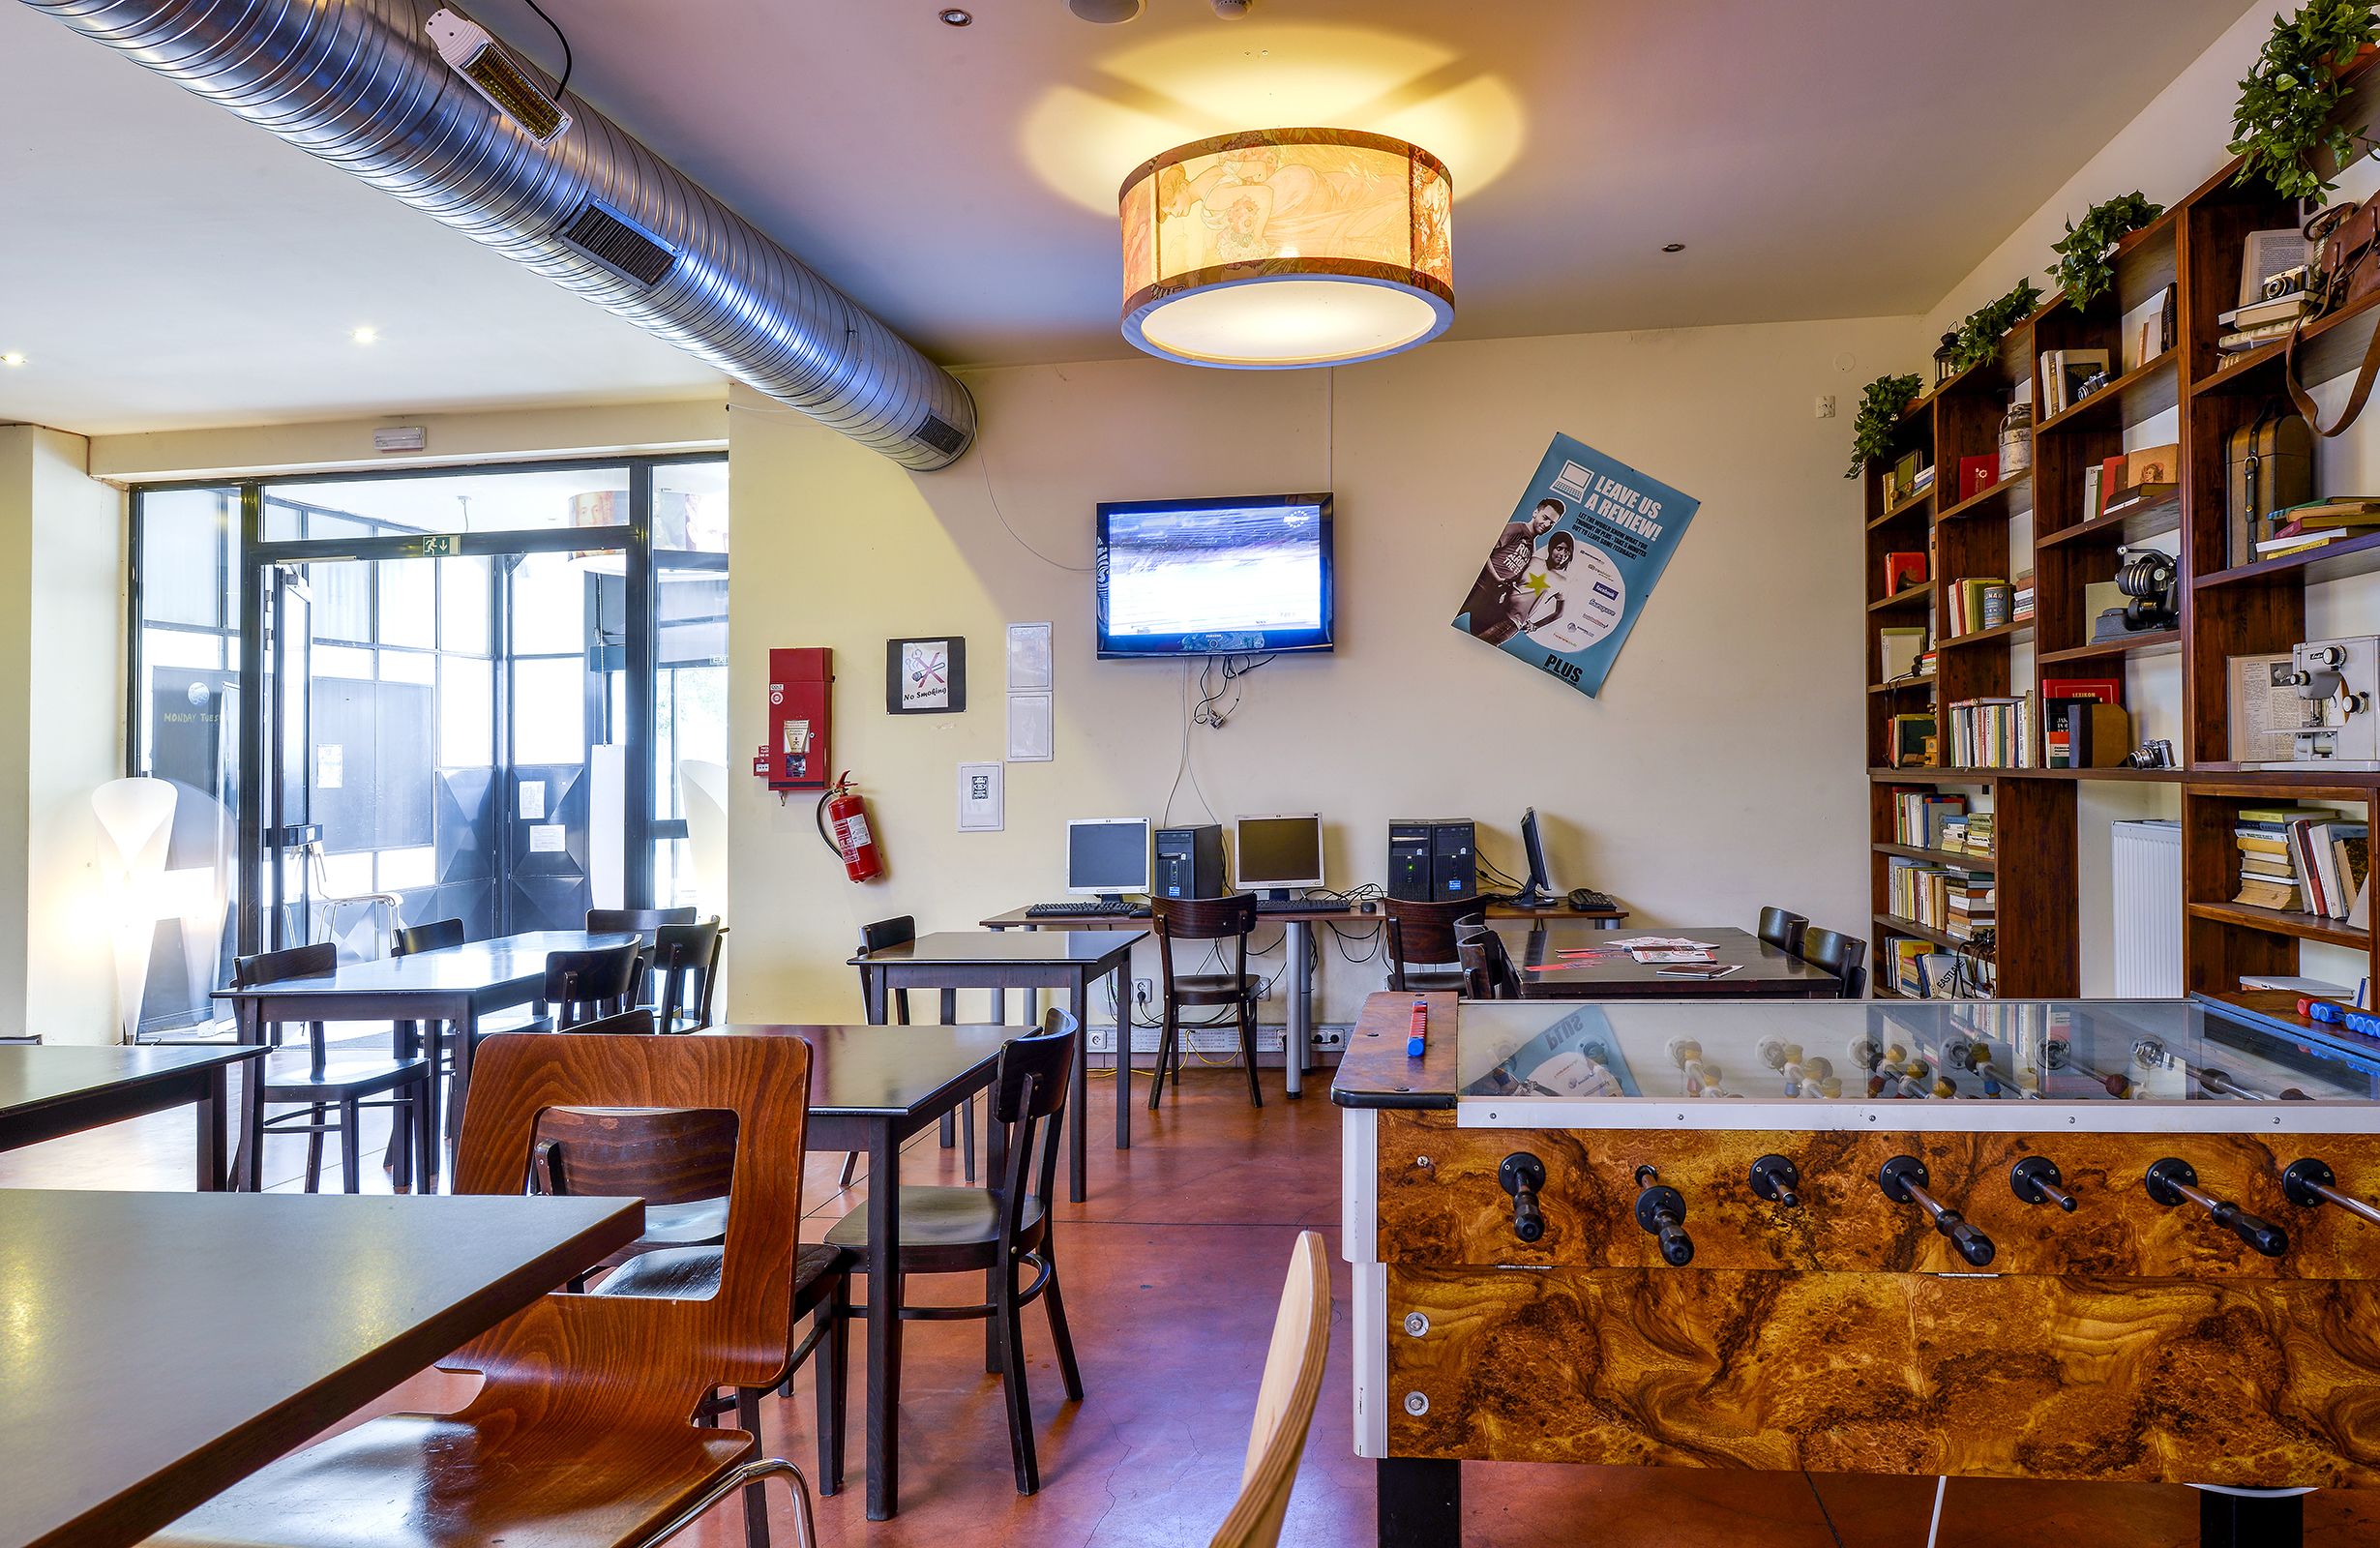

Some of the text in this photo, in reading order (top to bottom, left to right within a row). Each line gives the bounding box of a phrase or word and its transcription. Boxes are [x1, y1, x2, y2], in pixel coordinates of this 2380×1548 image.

[1594, 475, 1662, 519] LEAVE US
[1584, 492, 1663, 542] A REVIEW!
[1544, 653, 1584, 683] PLUS
[916, 687, 947, 699] Smoking
[164, 713, 195, 723] MONDAY
[1937, 959, 1966, 989] EASTLAE
